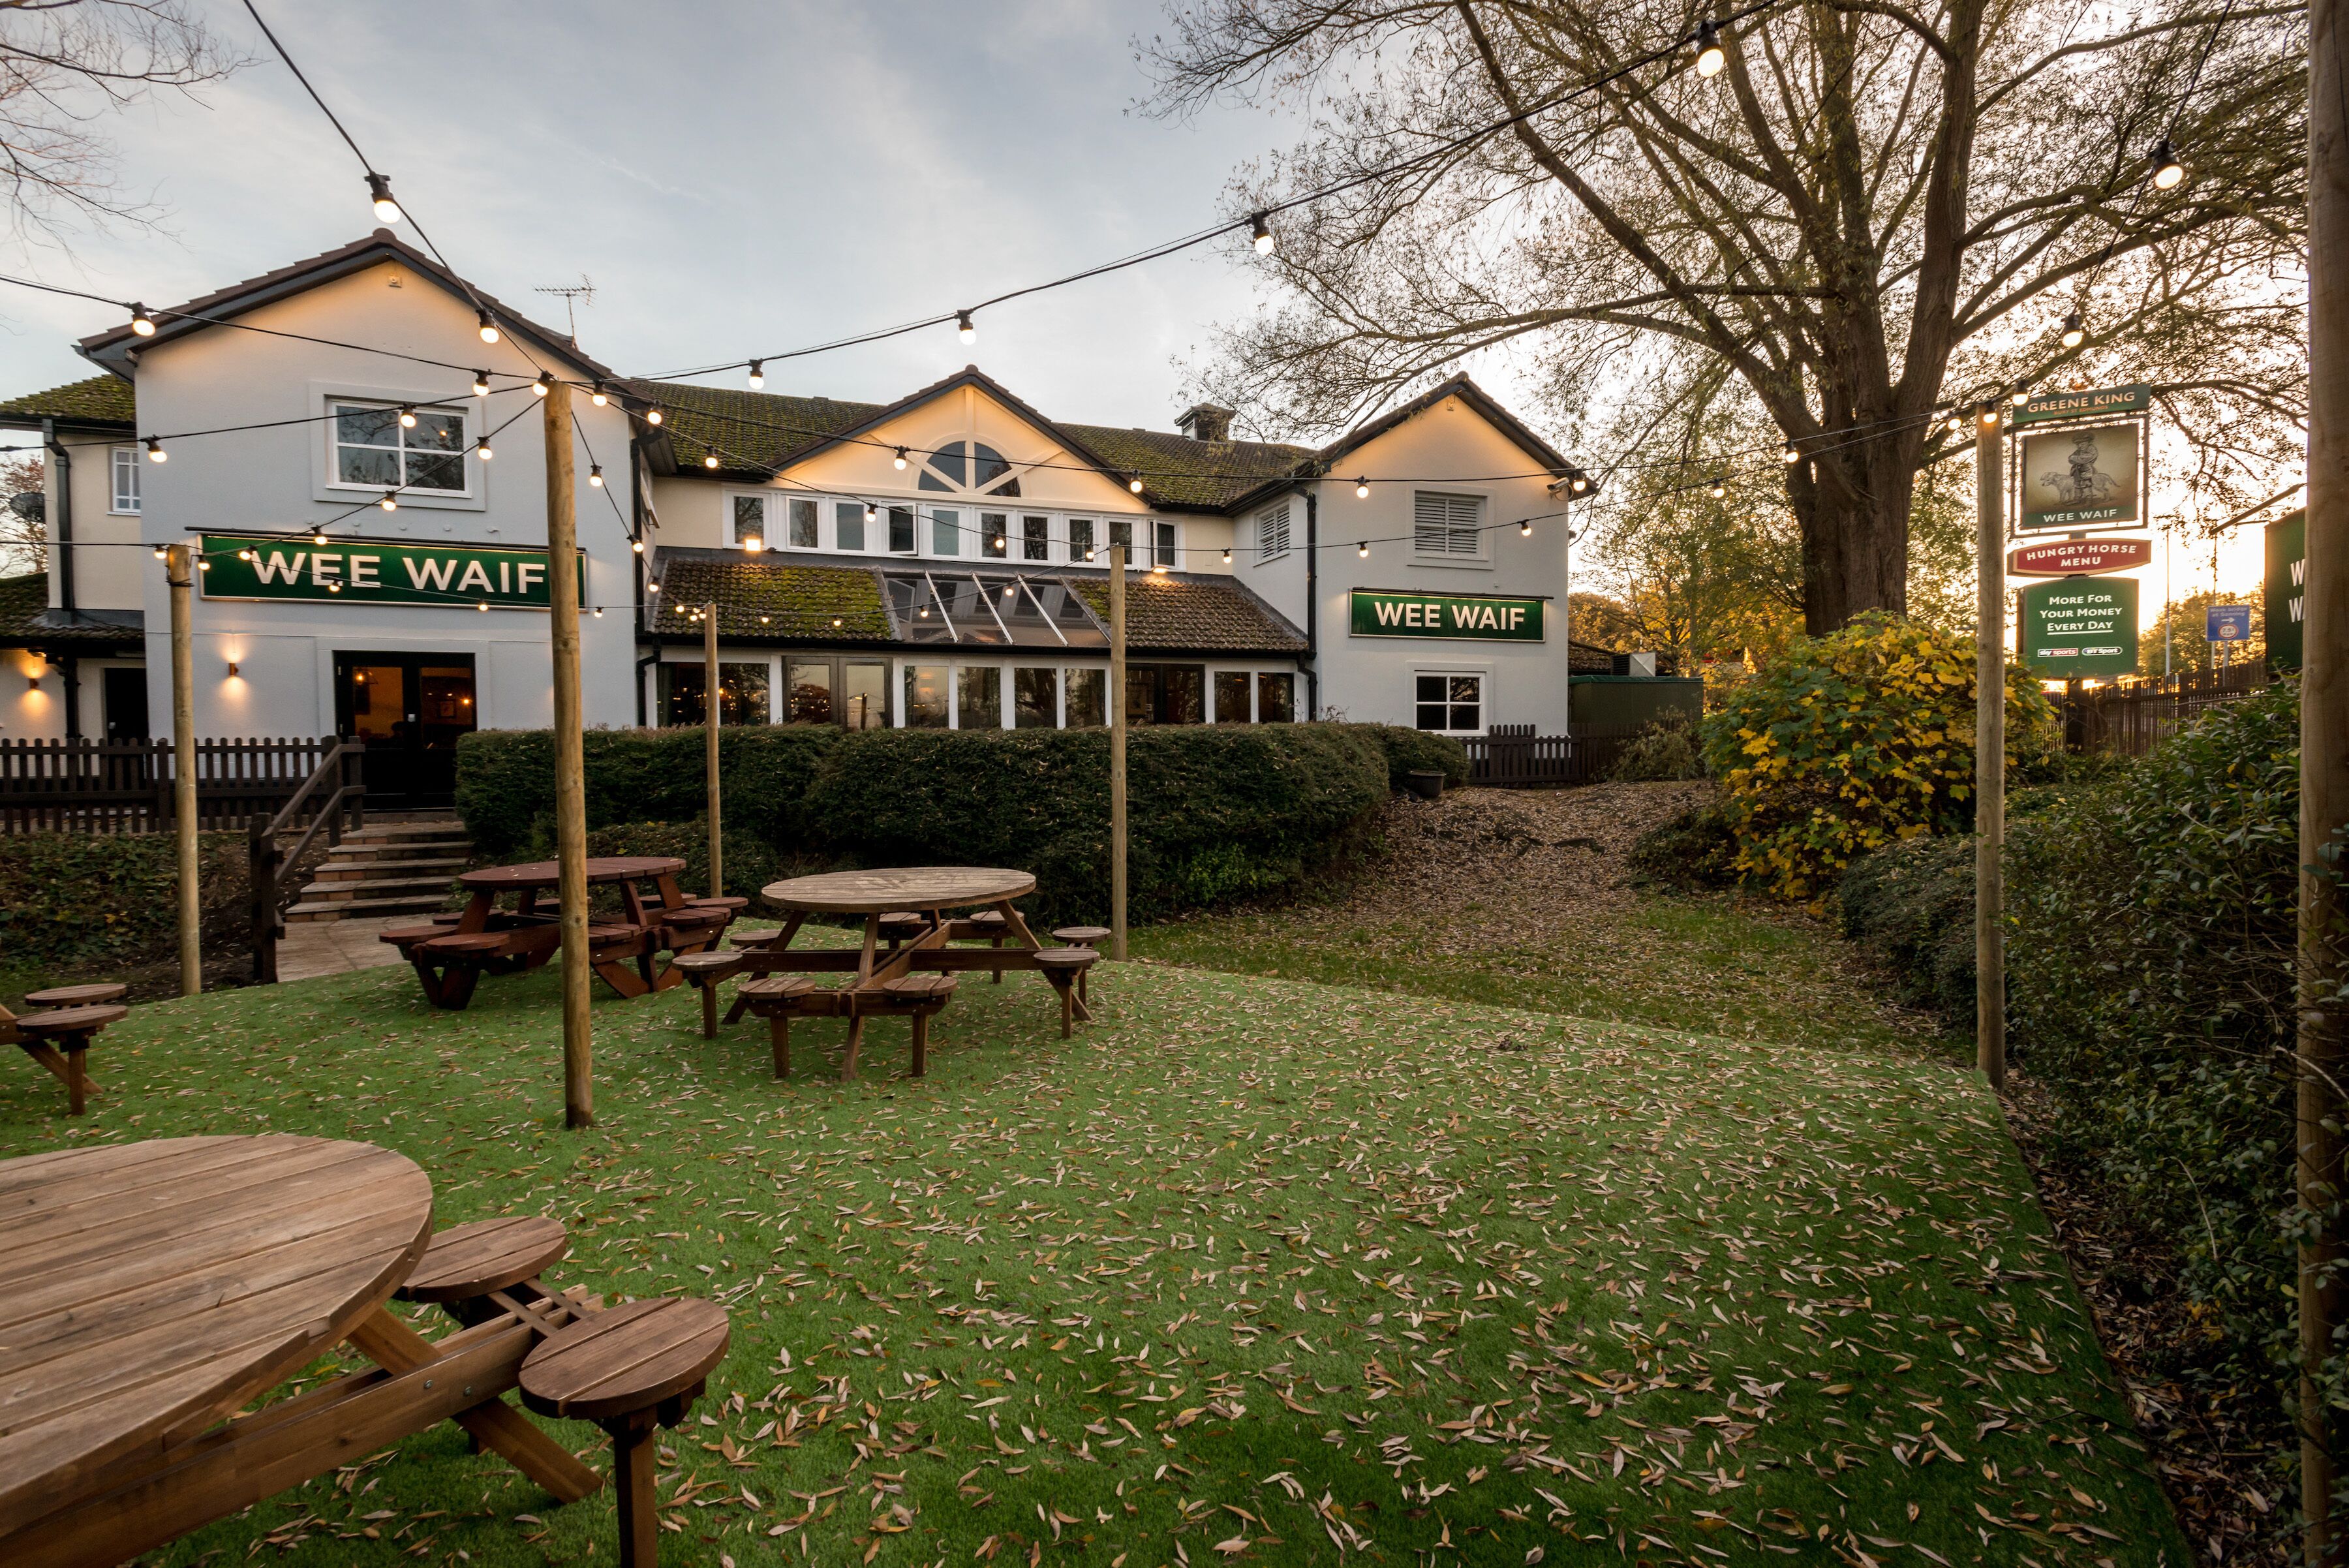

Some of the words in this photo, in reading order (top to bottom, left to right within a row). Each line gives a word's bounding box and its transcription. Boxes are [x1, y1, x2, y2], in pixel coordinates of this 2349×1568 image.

[2027, 397, 2089, 412] GREENE
[2094, 392, 2136, 405] KING
[2043, 513, 2075, 523] WEE
[2080, 509, 2117, 519] WAIF
[2026, 546, 2085, 561] HUNGRY
[2088, 545, 2137, 554] HORSE
[2061, 557, 2102, 567] MENU
[250, 551, 381, 587] WEE
[403, 557, 545, 594] WAIF
[2049, 596, 2084, 605] MORE
[2087, 594, 2112, 603] FOR
[1374, 602, 1441, 628] WEE
[1451, 605, 1525, 630] WAIF
[2040, 609, 2074, 619] YOUR
[2077, 607, 2123, 617] MONEY
[2047, 623, 2085, 631] EVERY
[2087, 621, 2113, 630] DAY
